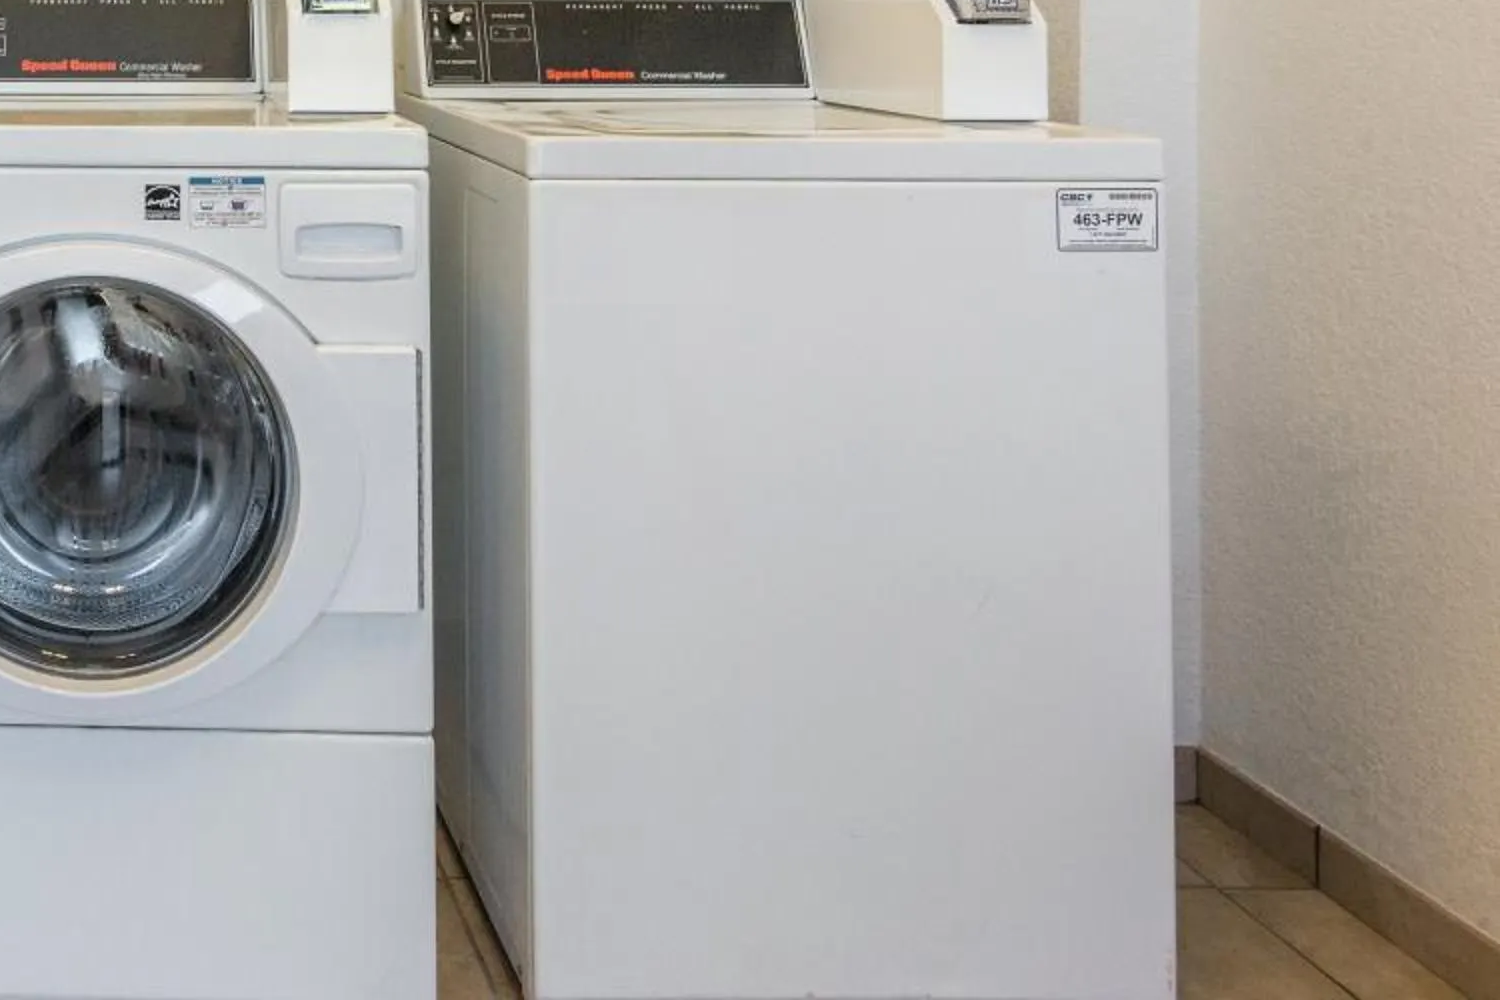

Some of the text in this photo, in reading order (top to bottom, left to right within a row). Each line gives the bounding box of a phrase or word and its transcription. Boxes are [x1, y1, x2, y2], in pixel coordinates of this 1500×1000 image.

[21, 59, 68, 73] Speed
[69, 58, 117, 71] Queen
[546, 68, 589, 81] Speed
[1073, 213, 1143, 226] 463-FPW
